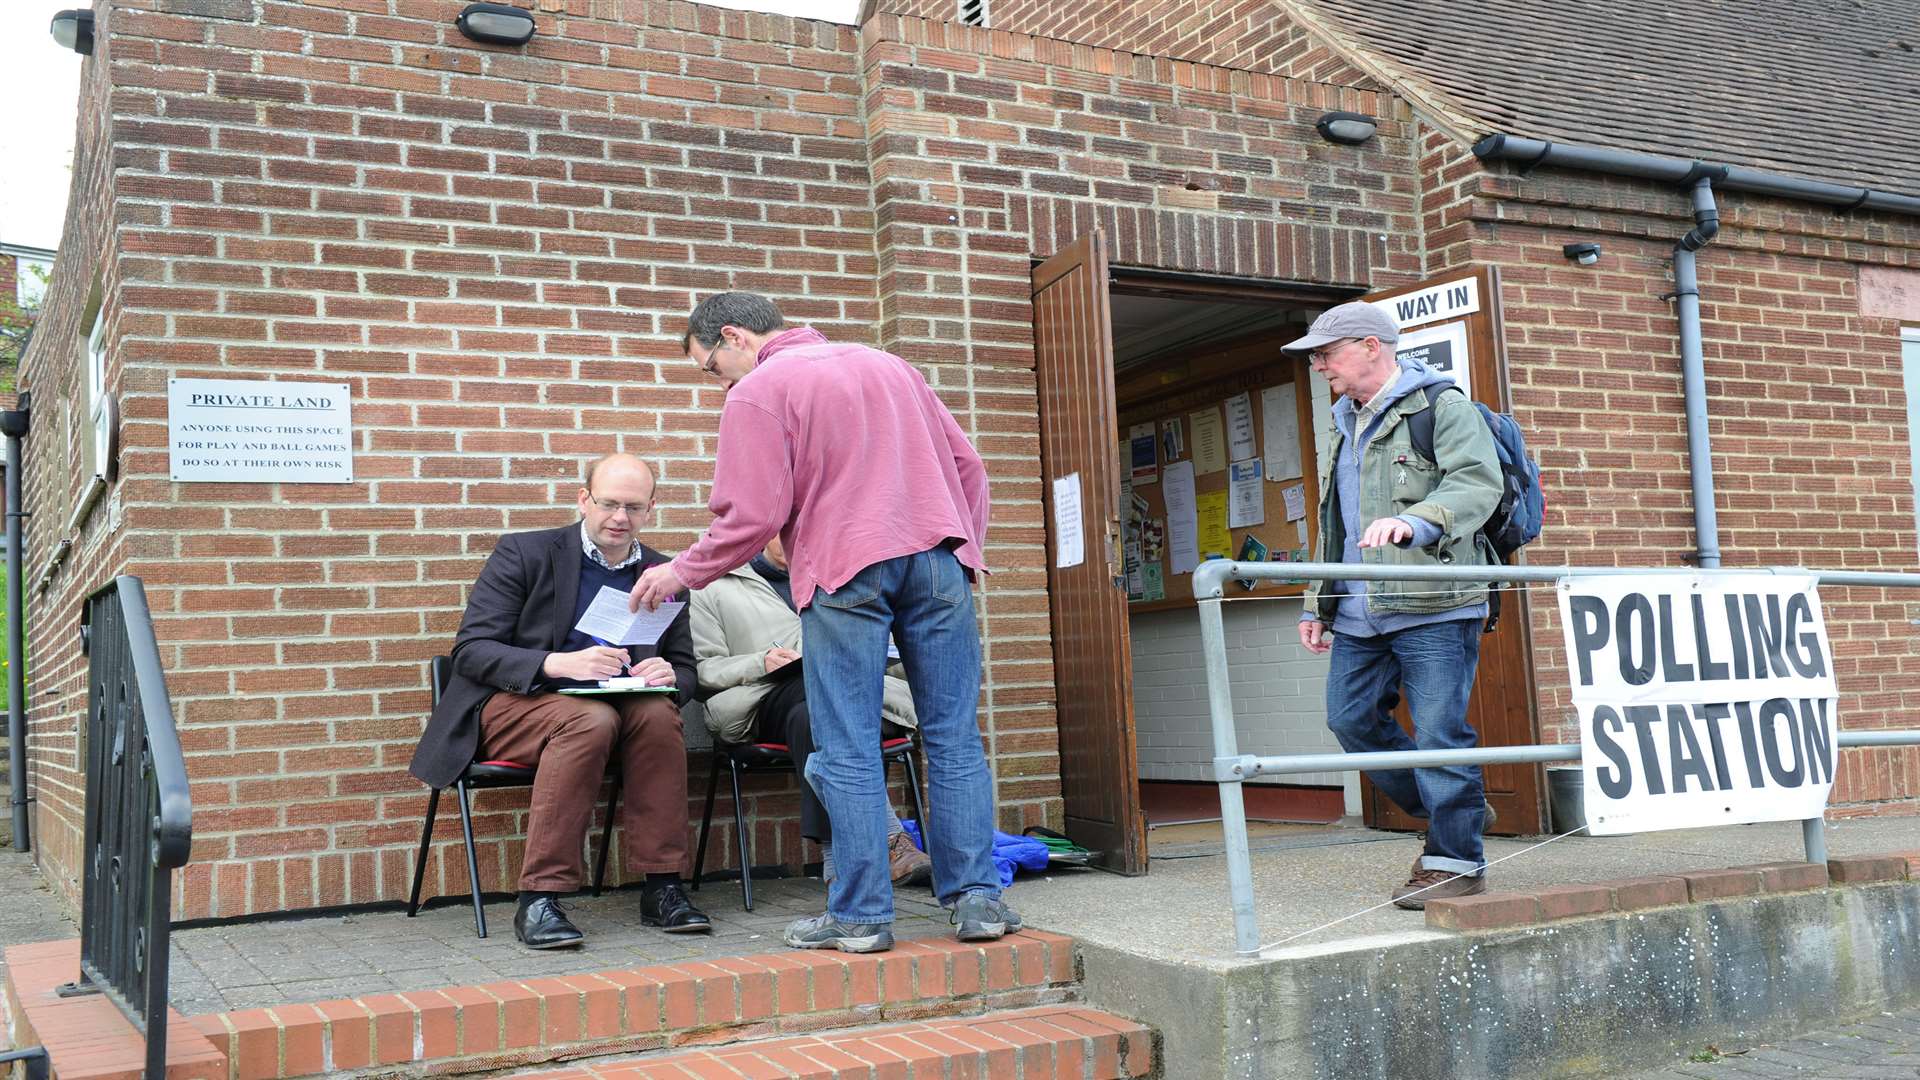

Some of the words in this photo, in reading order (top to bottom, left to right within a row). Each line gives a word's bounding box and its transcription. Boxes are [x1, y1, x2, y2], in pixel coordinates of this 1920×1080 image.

[1396, 292, 1439, 321] WAY
[1447, 285, 1469, 309] IN
[1396, 348, 1431, 361] WELCOME
[191, 393, 274, 407] PRIVATE
[280, 396, 332, 409] LAND
[180, 424, 233, 433] ANYONE
[235, 425, 273, 434] USING
[276, 426, 304, 435] THIS
[306, 427, 344, 435] SPACE
[178, 441, 203, 450] FOR
[207, 441, 239, 450] PLAY
[242, 442, 268, 451] AND
[271, 443, 302, 452] BALL
[304, 443, 347, 453] GAMES
[182, 459, 201, 467] DO
[202, 459, 220, 467] SO
[223, 459, 238, 468] AT
[244, 460, 280, 469] THEIR
[282, 460, 313, 469] OWN
[315, 461, 344, 470] RISK
[1569, 592, 1828, 686] POLLING
[1592, 696, 1833, 800] STATION
